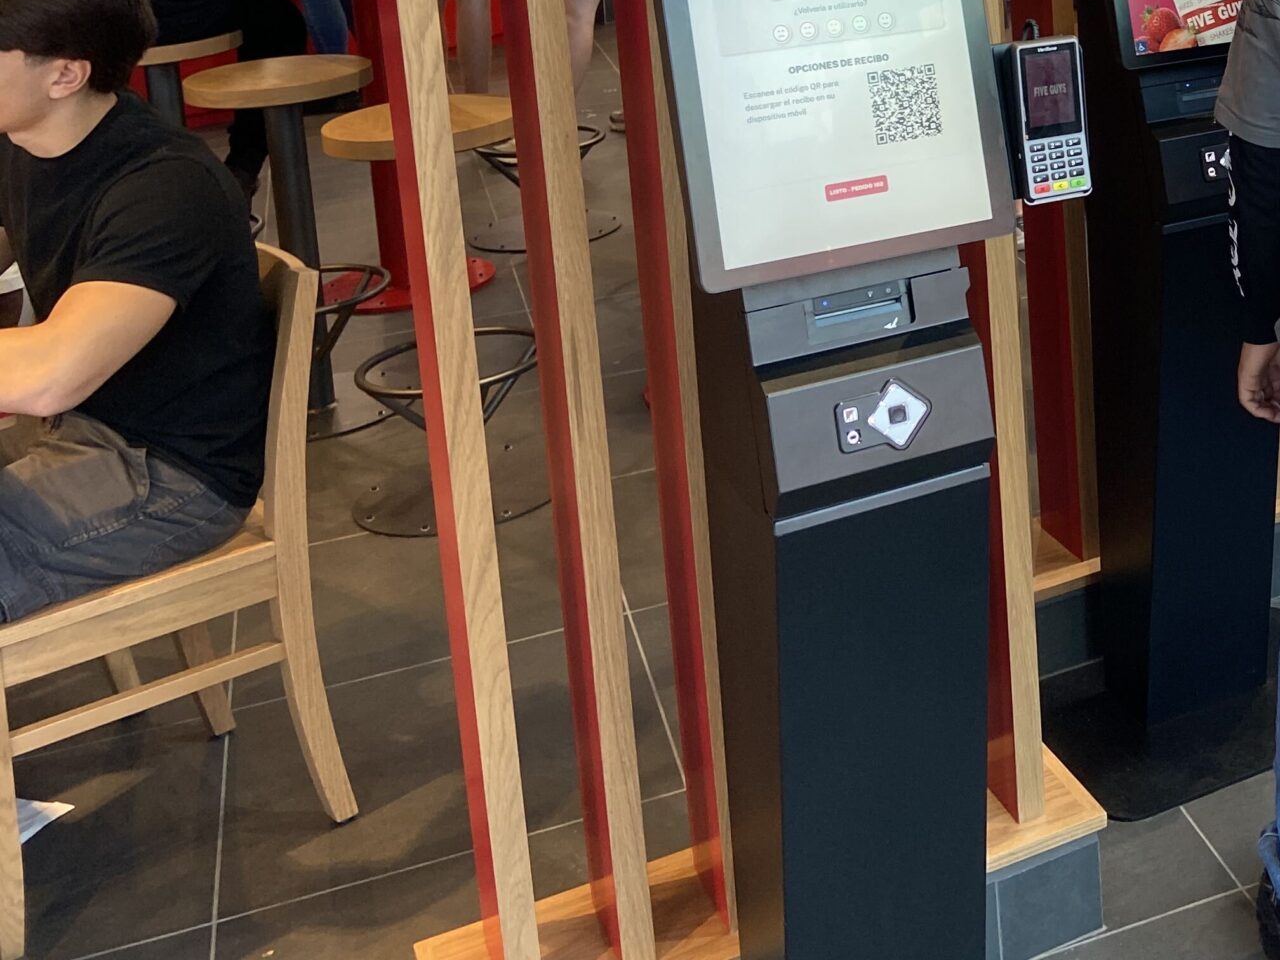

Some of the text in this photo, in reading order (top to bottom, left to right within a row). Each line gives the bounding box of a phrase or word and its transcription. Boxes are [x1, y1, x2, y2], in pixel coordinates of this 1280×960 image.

[1187, 9, 1216, 30] FIVE
[1217, 0, 1243, 18] GUY
[788, 53, 890, 74] OPCIONES DE RECIBO
[743, 80, 839, 100] Escanea el código QR para
[1034, 83, 1067, 97] FIVE GUYS
[745, 93, 835, 113] descargar el recibo en su
[747, 111, 786, 124] dispositivo
[829, 187, 848, 196] LISTO
[851, 183, 873, 193] PEDIDO
